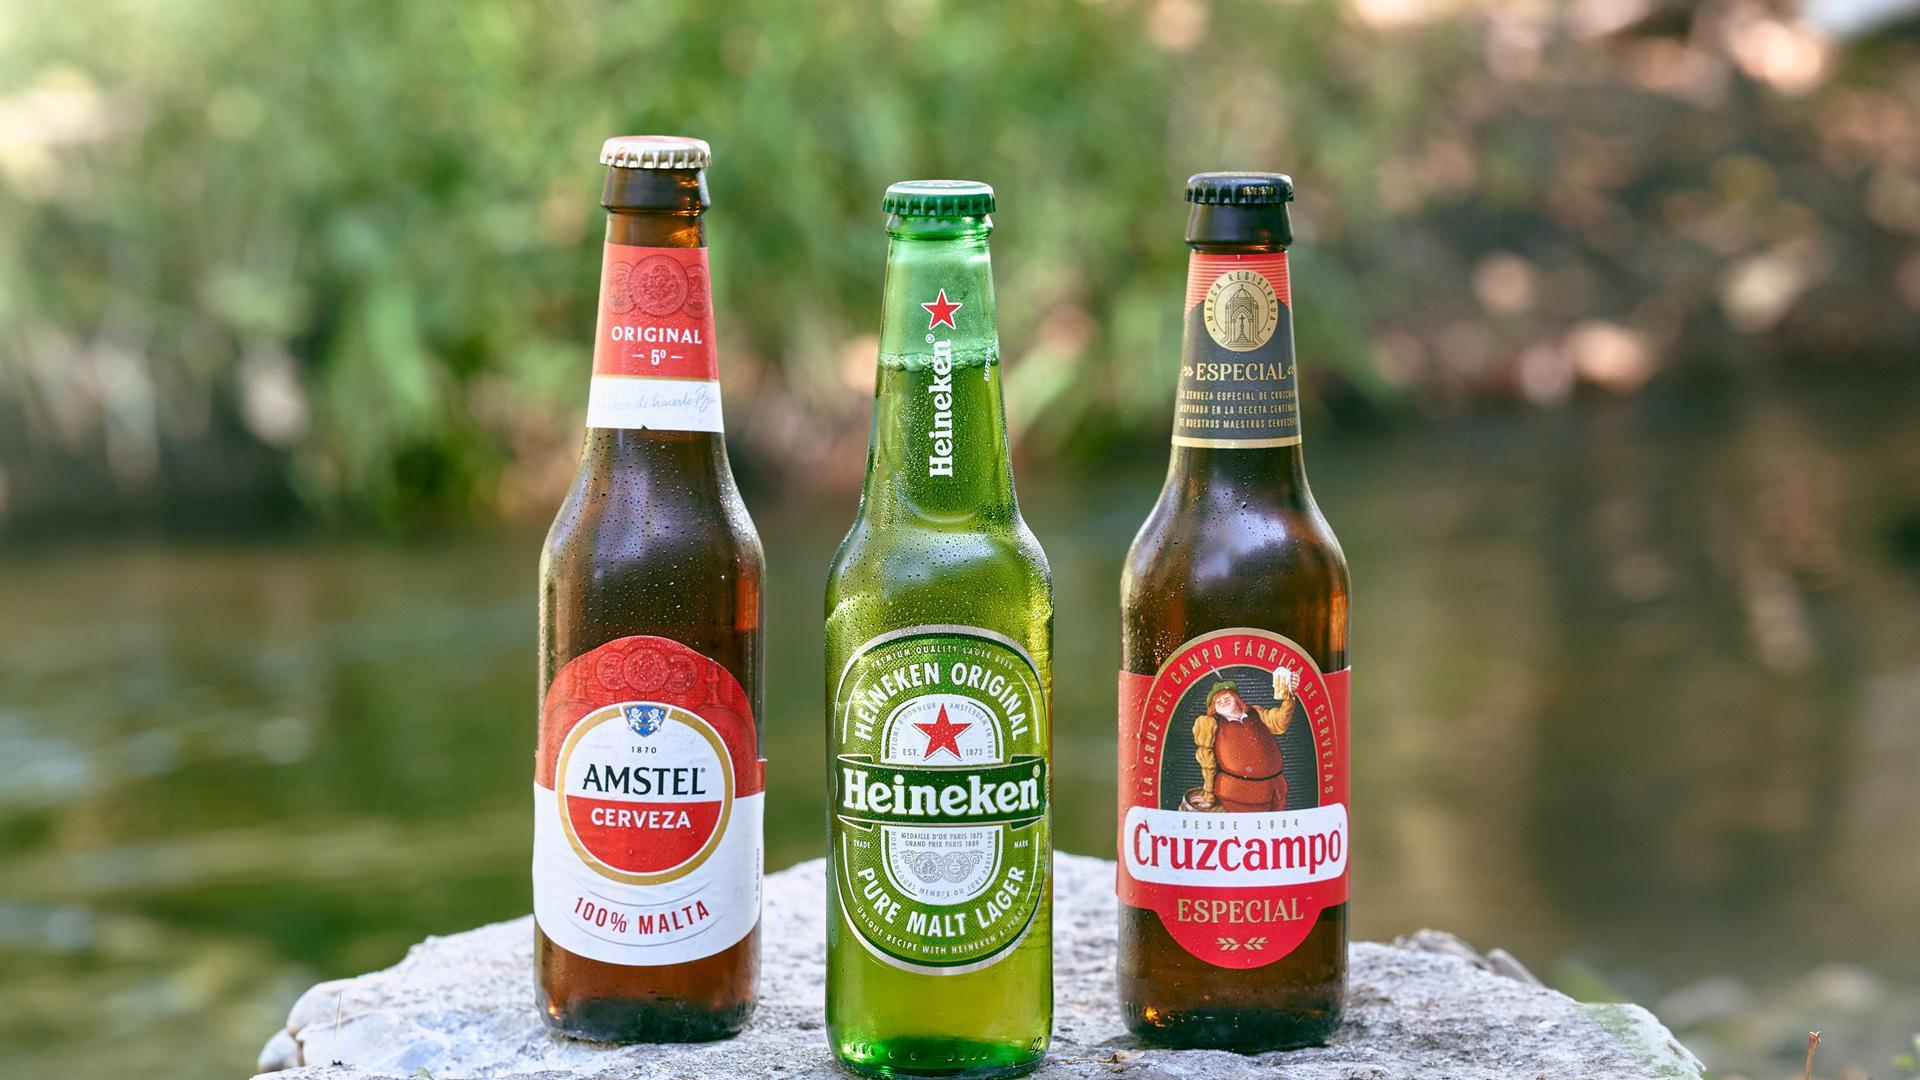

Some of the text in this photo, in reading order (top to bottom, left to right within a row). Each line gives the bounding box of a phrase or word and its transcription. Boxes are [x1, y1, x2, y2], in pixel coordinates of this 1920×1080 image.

[1206, 272, 1276, 321] MARCA REGISTRADA
[611, 326, 702, 344] ORIGINAL
[1195, 362, 1287, 381] ESPECIAL
[1217, 391, 1255, 400] ESPECIAL
[1259, 391, 1268, 400] DE
[929, 339, 953, 478] Heineken
[1212, 405, 1221, 415] EN
[1225, 405, 1235, 415] LA
[1239, 405, 1267, 415] RECETA
[1223, 420, 1265, 429] MAESTROS
[916, 645, 957, 654] QUALITY
[963, 646, 991, 659] LAGER
[1170, 644, 1223, 685] CAMPO
[855, 662, 1029, 741] HEINEKEN ORIGINAL
[1155, 689, 1173, 714] DEL
[1304, 681, 1317, 700] DE
[631, 746, 657, 754] 1870
[903, 748, 920, 756] EST.
[1143, 720, 1160, 765] CRUZ
[1314, 703, 1334, 794] CERVEZAS
[582, 763, 706, 796] AMSTEL
[843, 767, 1040, 816] Heineken
[1142, 777, 1154, 796] LA
[591, 807, 691, 829] CERVEZA
[1182, 819, 1238, 830] DESDE
[905, 840, 926, 848] GRAND
[945, 840, 963, 848] PARIS
[1134, 817, 1342, 875] Cruzcampo
[858, 865, 1026, 937] PURE MALT LAGER
[1177, 897, 1304, 924] ESPECIAL
[574, 896, 710, 935] 100% MALTA
[857, 906, 884, 936] UNIQUE
[886, 934, 918, 951] RECIPE
[922, 946, 946, 954] WITH
[951, 934, 996, 954] HEINEKEN
